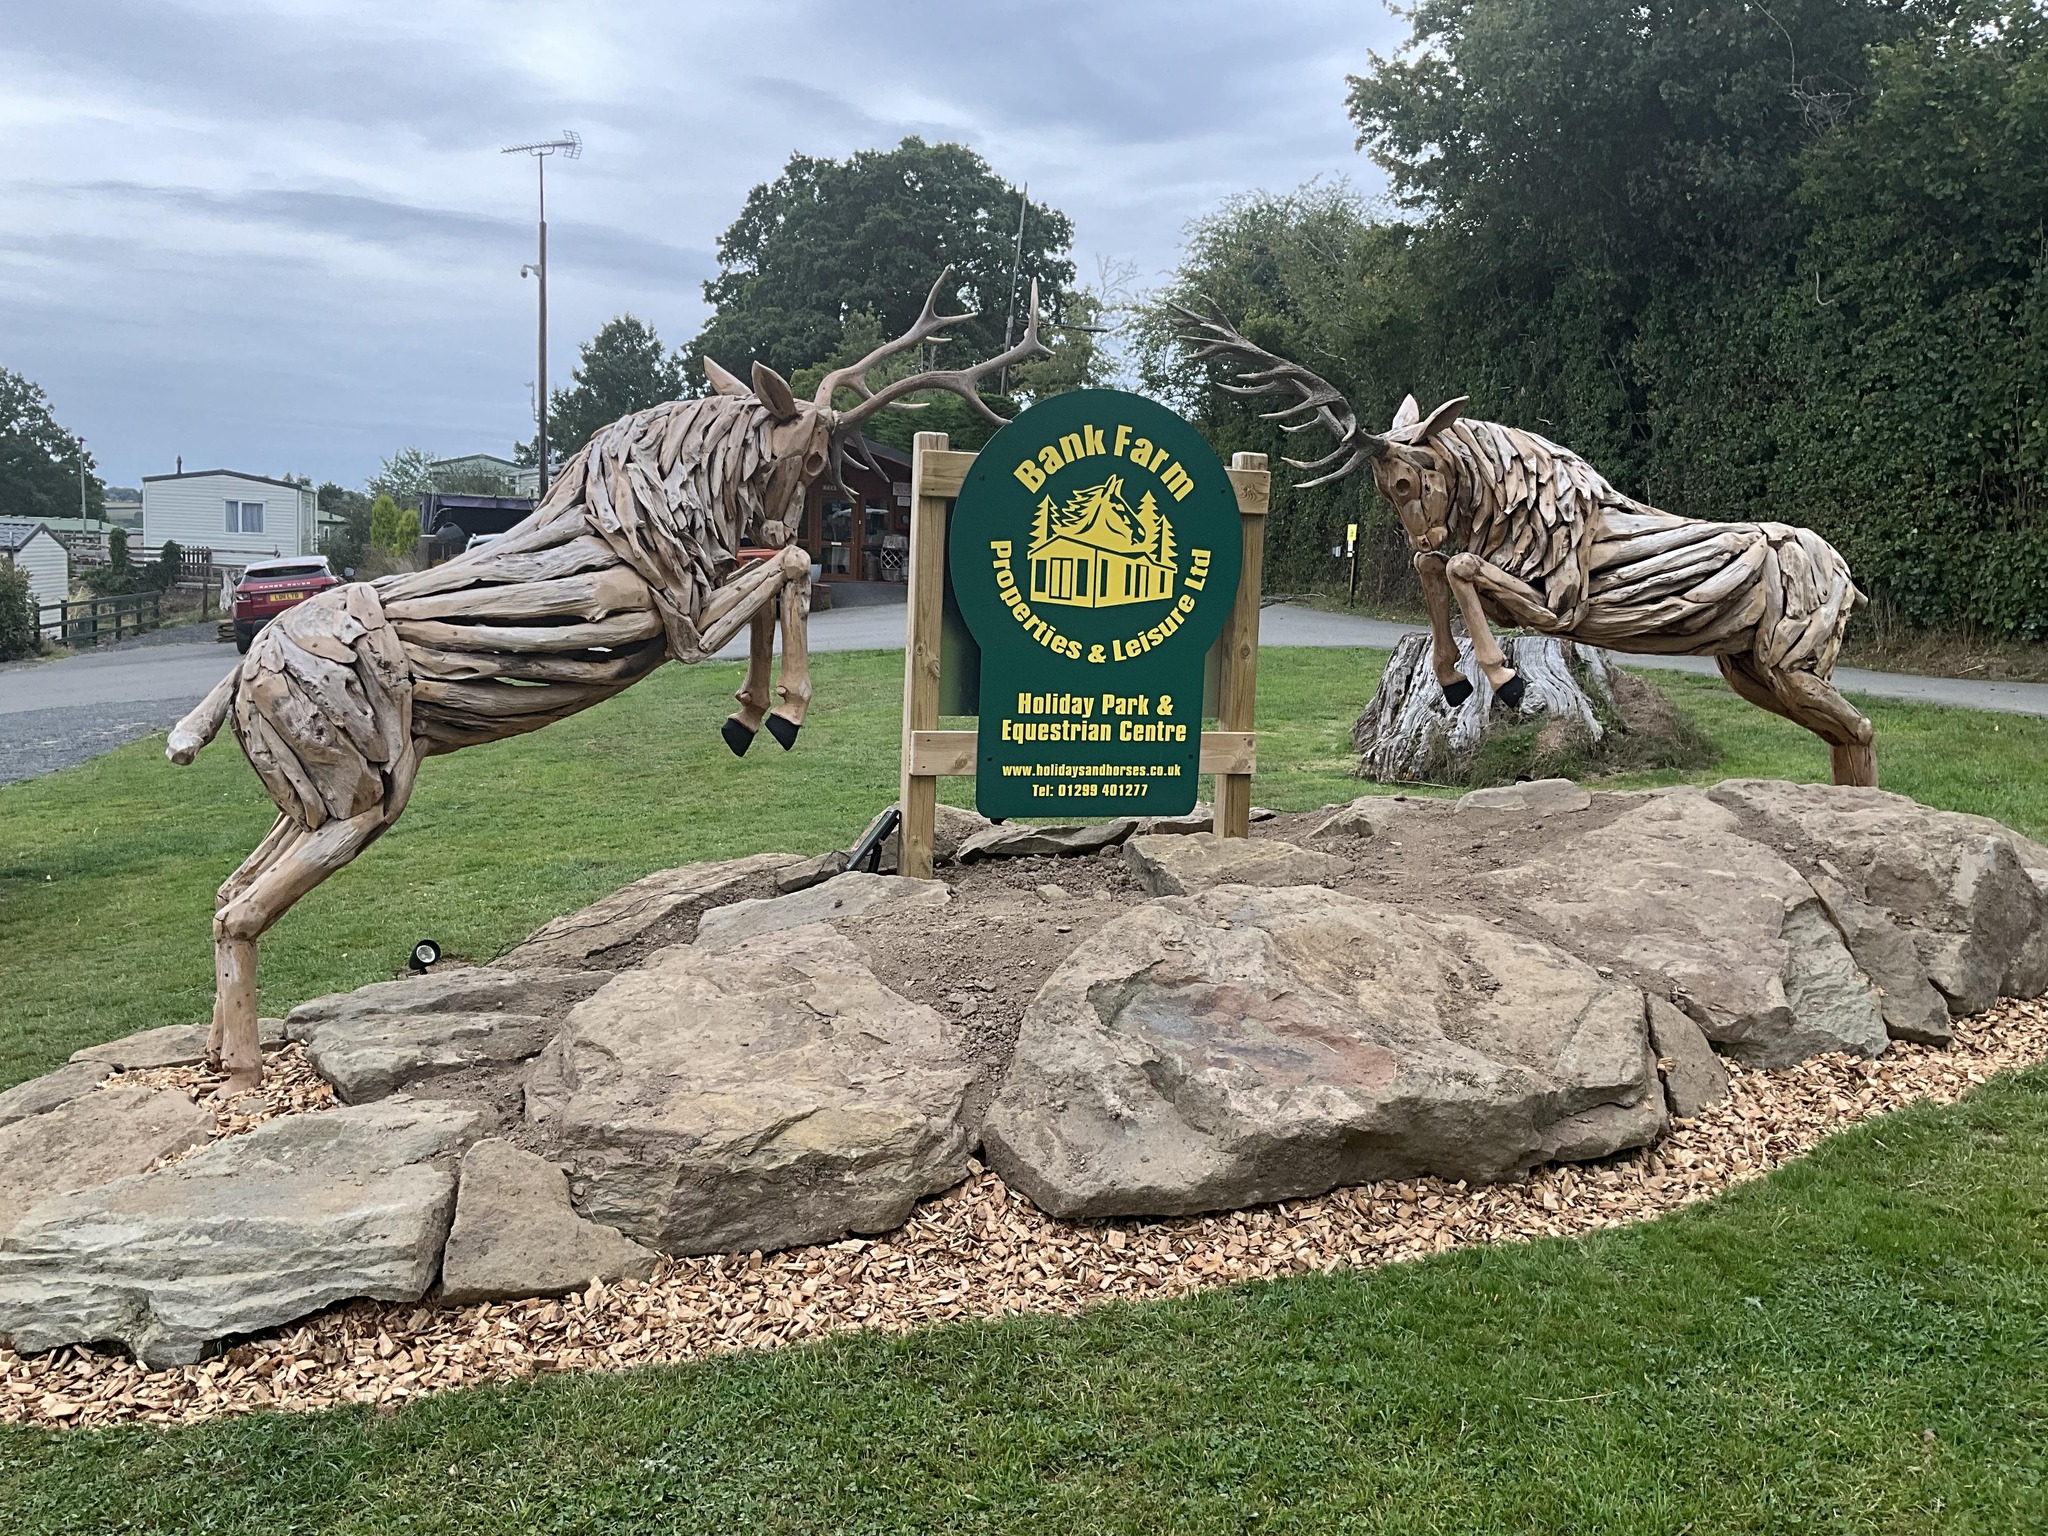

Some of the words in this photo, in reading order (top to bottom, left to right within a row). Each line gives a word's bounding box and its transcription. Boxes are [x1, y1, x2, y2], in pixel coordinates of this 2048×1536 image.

[1013, 424, 1106, 494] Bank
[1113, 424, 1195, 502] Farm
[990, 540, 1083, 660] Properties
[1087, 644, 1107, 664] &
[1112, 594, 1196, 662] Leisure
[1184, 548, 1212, 592] Ltd
[1017, 692, 1095, 718] Holiday
[1101, 693, 1150, 716] Park
[1156, 695, 1174, 716] &
[1001, 719, 1112, 744] Equestrian
[1119, 720, 1187, 742] Centre
[1002, 763, 1181, 778] www.holidaysandhorses.co.uk
[1032, 784, 1054, 797] Tel:
[1058, 784, 1098, 797] 01299
[1101, 783, 1149, 797] 401277
